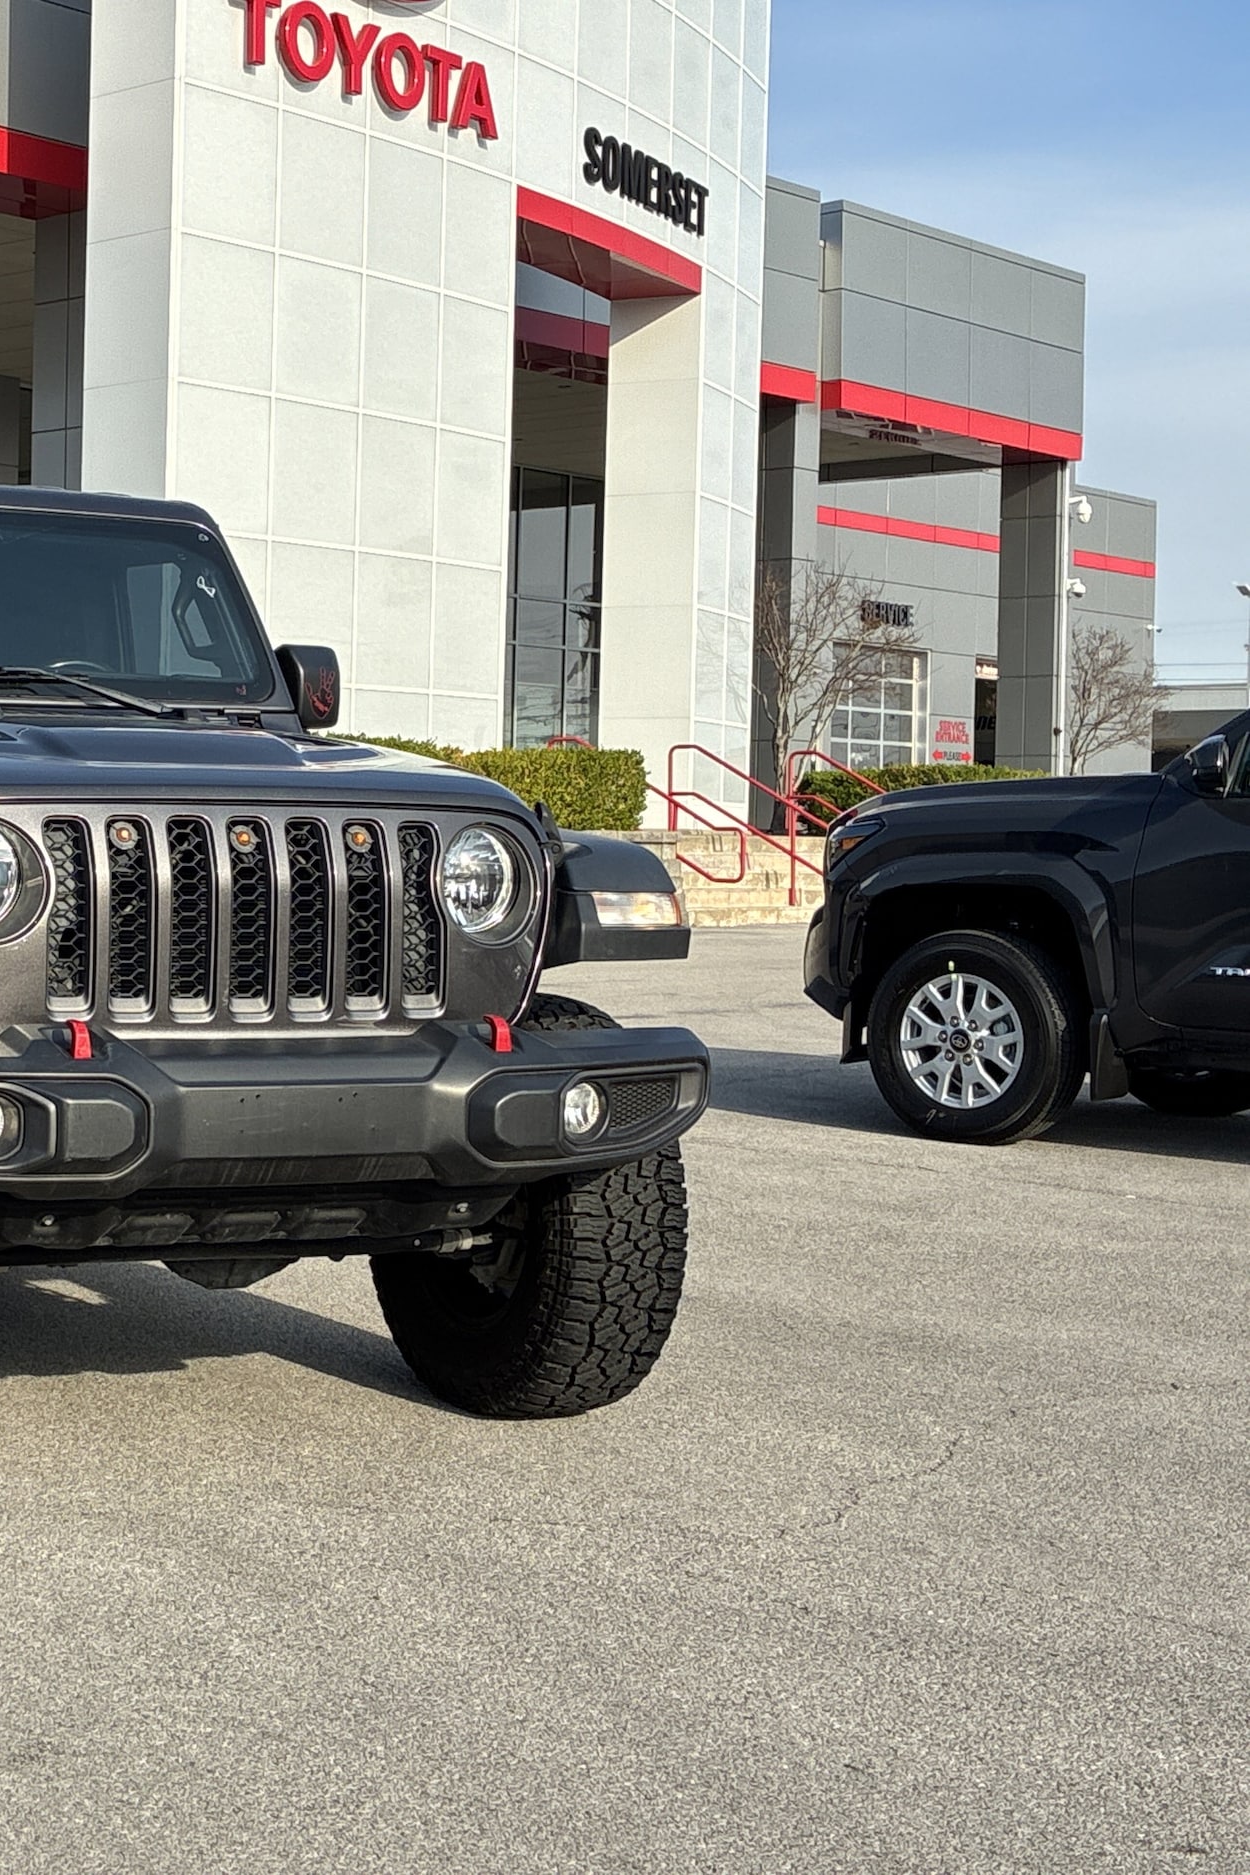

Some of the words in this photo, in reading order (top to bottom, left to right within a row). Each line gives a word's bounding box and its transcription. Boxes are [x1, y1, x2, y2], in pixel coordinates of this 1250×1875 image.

[228, 0, 499, 141] TOYOTA
[582, 126, 710, 238] SOMERSET
[860, 600, 915, 627] SERVICE
